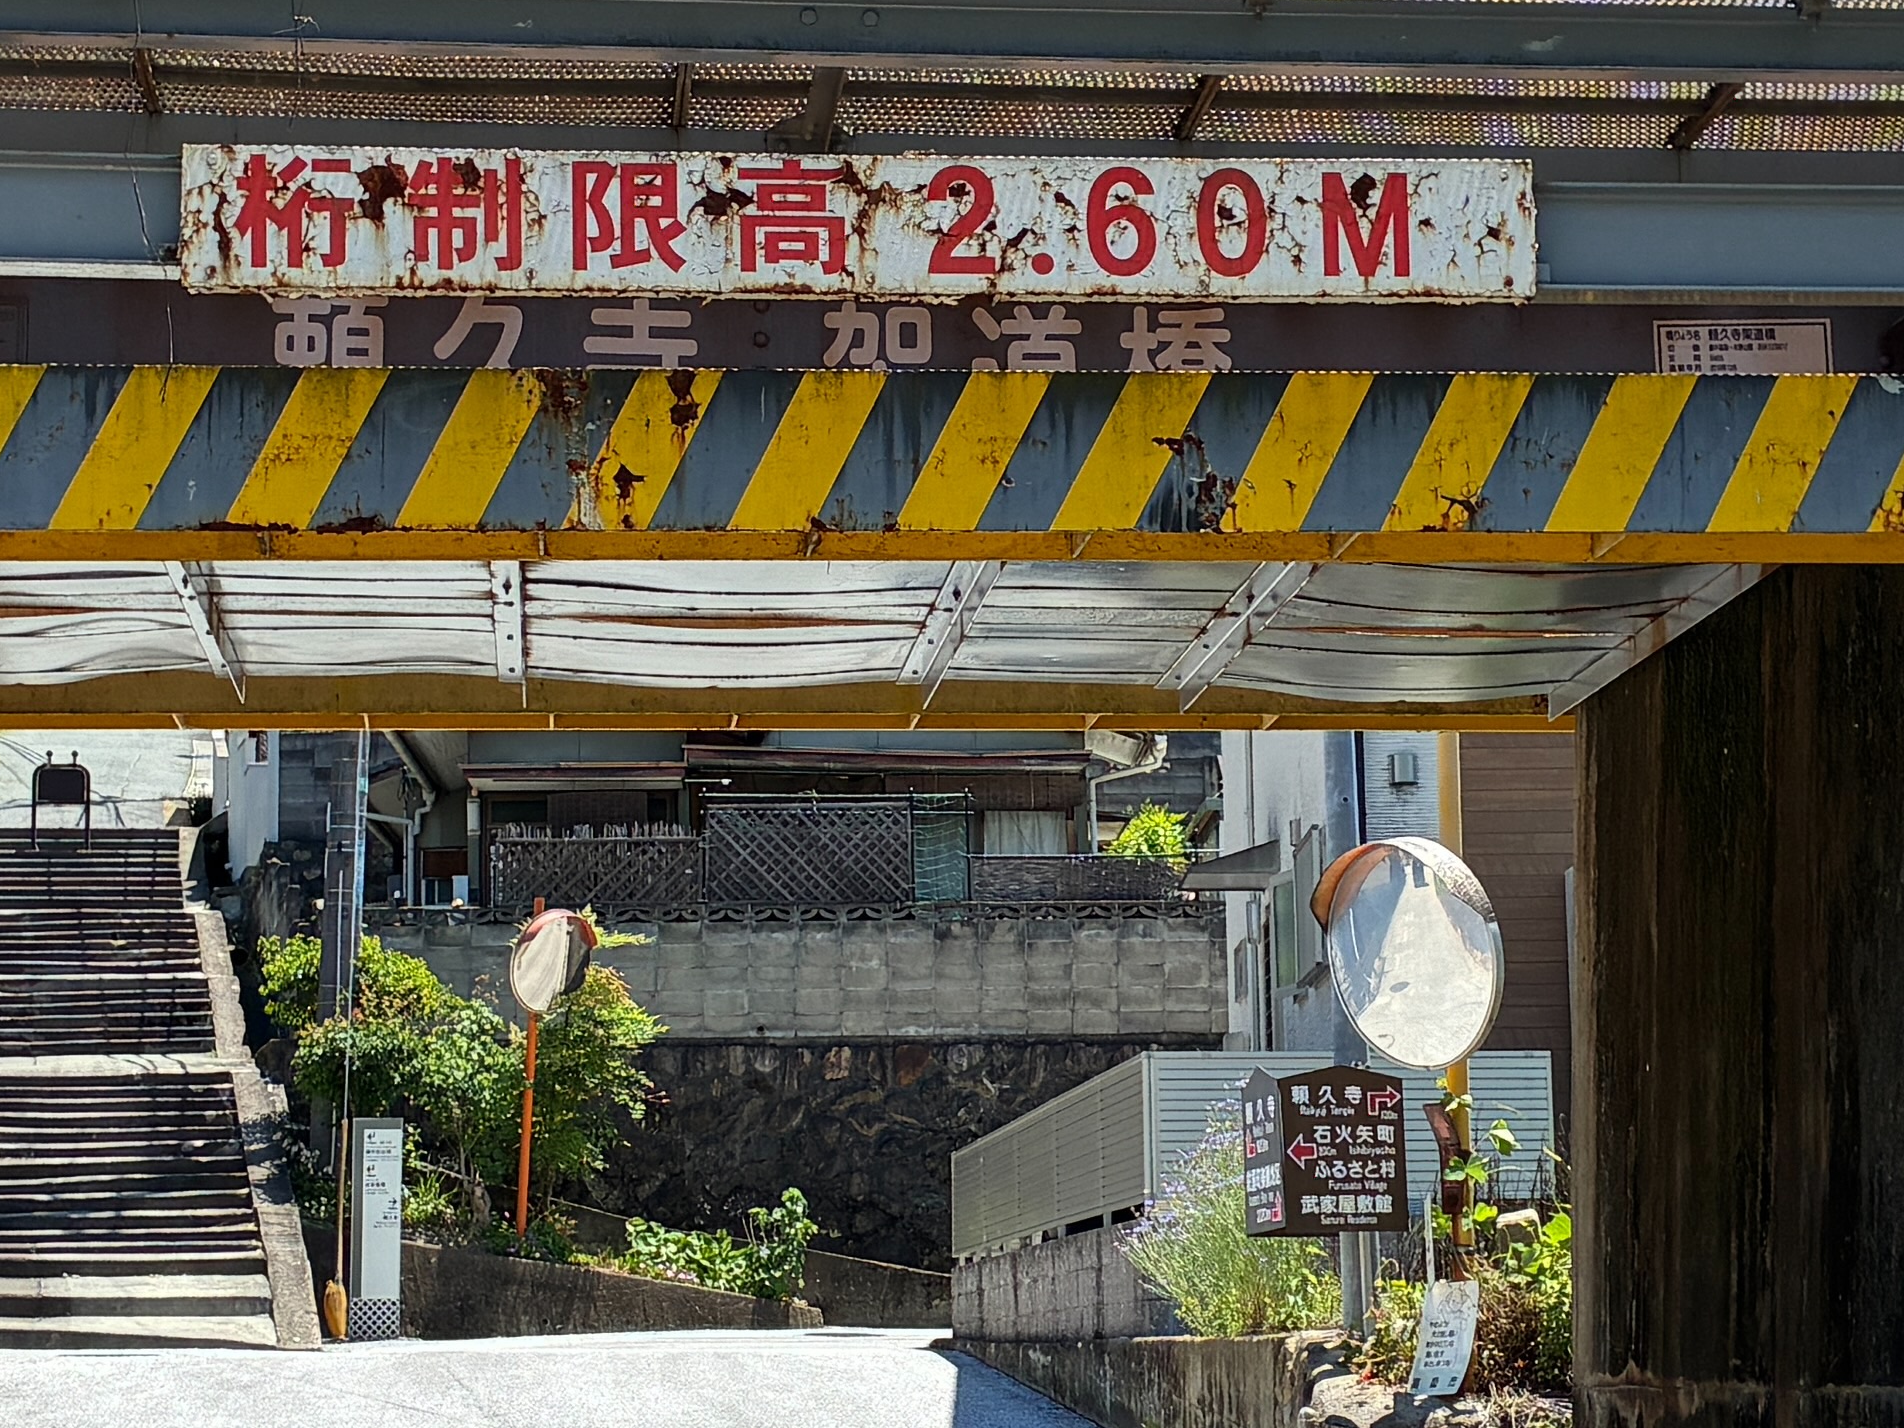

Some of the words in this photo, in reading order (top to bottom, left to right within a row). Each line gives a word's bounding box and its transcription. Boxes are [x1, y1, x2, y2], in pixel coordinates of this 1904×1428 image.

[1313, 1124, 1395, 1144] 石火矢町
[1315, 1159, 1396, 1179] ふるさと村
[1300, 1194, 1393, 1214] 武家屋敷館
